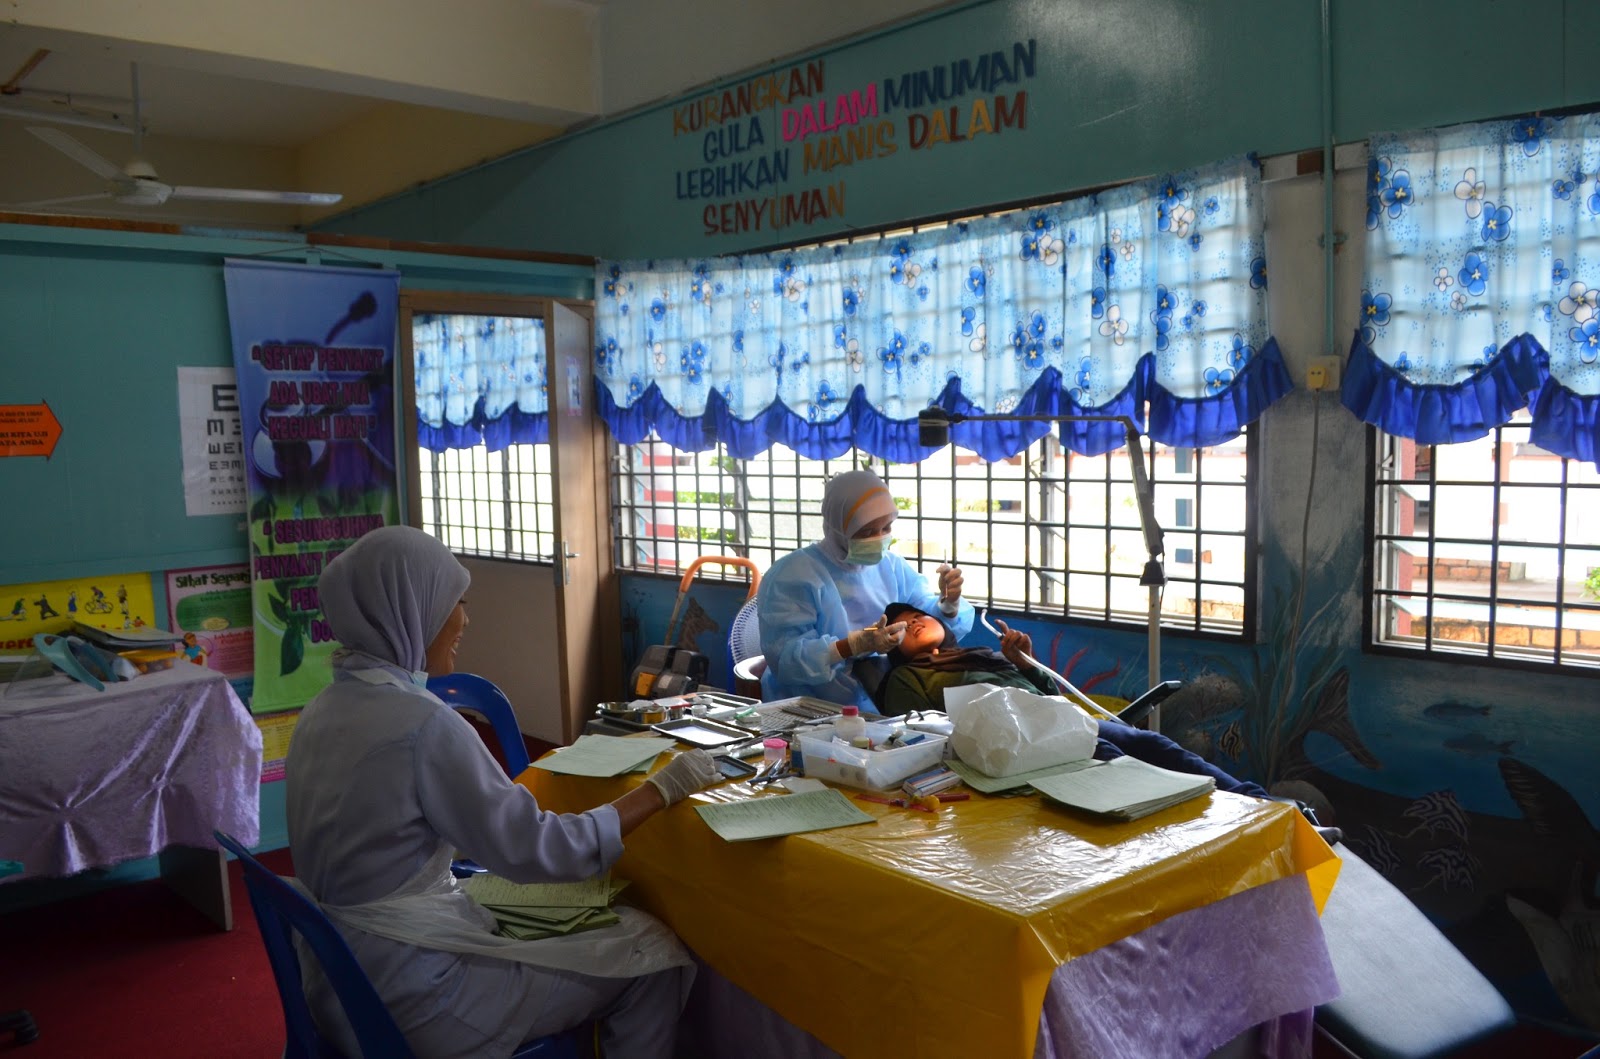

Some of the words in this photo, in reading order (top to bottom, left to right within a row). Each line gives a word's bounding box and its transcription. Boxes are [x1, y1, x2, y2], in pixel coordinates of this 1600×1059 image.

[674, 59, 824, 136] KURANGKAN
[703, 116, 764, 163] GULA
[781, 83, 878, 142] DALAM
[883, 39, 1036, 113] MINUMAN
[676, 148, 789, 200] LEBIHKAN
[803, 120, 897, 176] MANIS
[908, 91, 1028, 150] DALAM
[703, 181, 845, 236] SENYUMAN
[318, 348, 384, 371] PENYAKIT
[269, 381, 300, 405] ADA
[301, 381, 339, 405] UBAT
[268, 416, 331, 441] KECUALI
[254, 552, 323, 580] PENYAKIT
[290, 586, 320, 612] PEN
